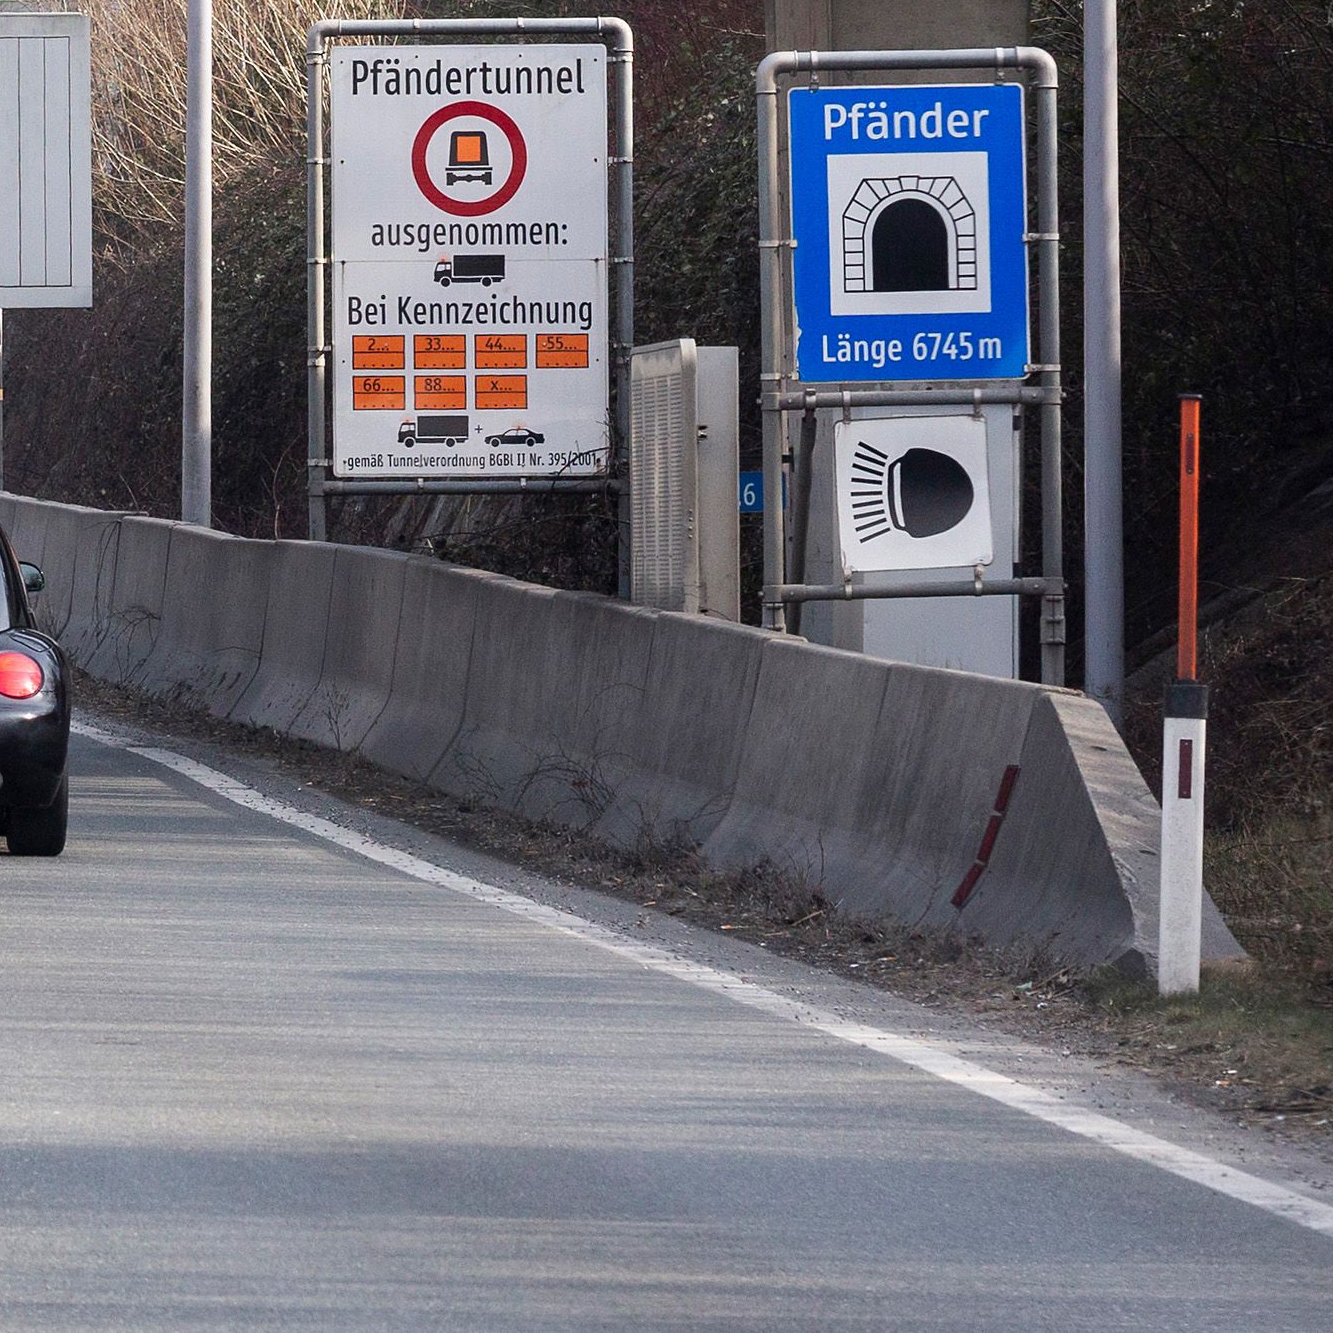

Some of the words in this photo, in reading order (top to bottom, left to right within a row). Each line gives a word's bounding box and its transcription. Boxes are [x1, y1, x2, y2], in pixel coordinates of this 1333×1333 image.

[351, 58, 585, 95] Pfändertunnel
[823, 102, 990, 140] Pfänder
[371, 222, 568, 253] ausgenommen:
[348, 295, 386, 325] Bei
[398, 294, 592, 330] Kennzeichnung
[822, 334, 902, 368] Länge
[912, 332, 974, 361] 6745
[978, 337, 1002, 359] m
[347, 453, 384, 470] gemäß
[387, 453, 485, 469] Tunnelverordnung
[529, 453, 545, 466] Nr.
[548, 451, 597, 467] 395/2001
